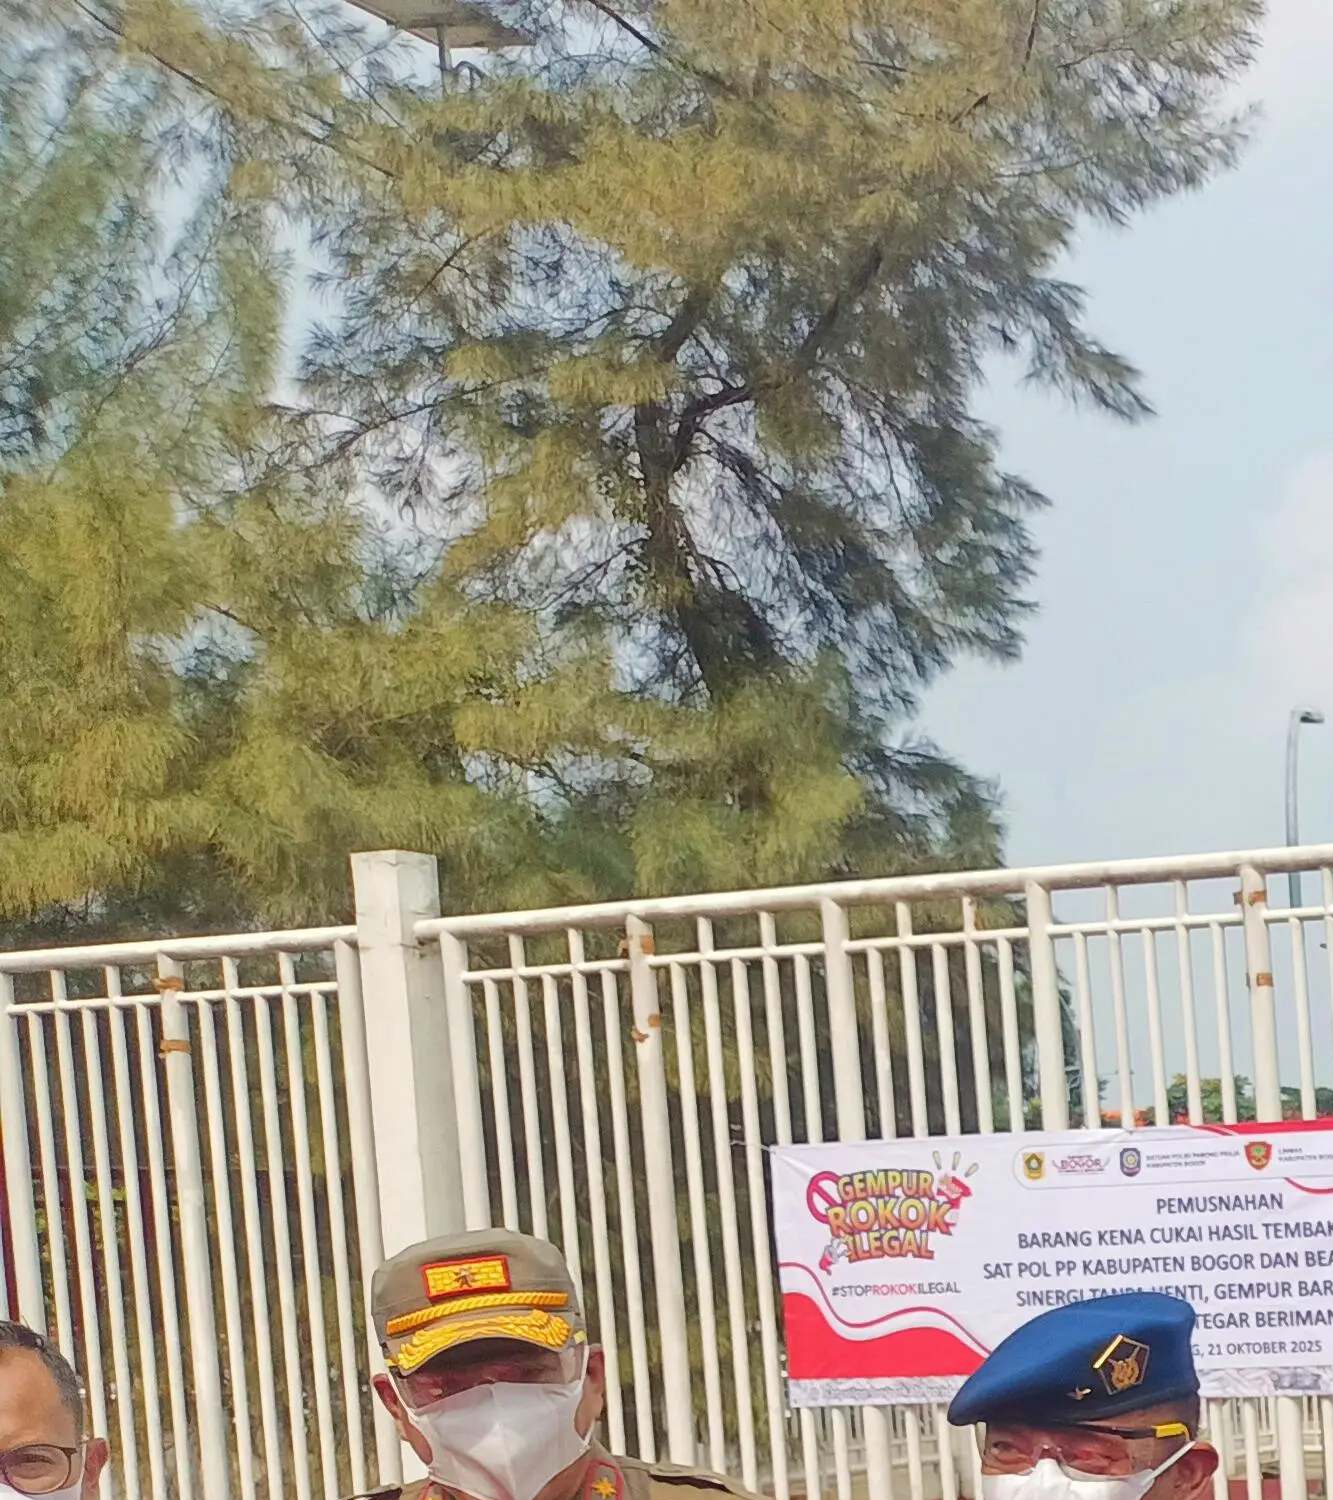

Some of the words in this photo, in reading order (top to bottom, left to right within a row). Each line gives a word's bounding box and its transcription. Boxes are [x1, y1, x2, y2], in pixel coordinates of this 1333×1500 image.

[837, 1169, 935, 1200] GEMPUR
[1156, 1192, 1284, 1215] PEMUSNAHAN
[826, 1197, 954, 1238] ROKOK
[843, 1230, 935, 1263] ILEGAL
[1017, 1230, 1092, 1249] BARANG
[1098, 1228, 1146, 1246] KENA
[1149, 1226, 1203, 1244] CUKAI
[1208, 1224, 1259, 1242] HASIL
[983, 1262, 1013, 1280] SAT
[1018, 1261, 1051, 1278] POL
[1055, 1260, 1077, 1276] PP
[1082, 1256, 1185, 1276] KABUPATEN
[1190, 1252, 1255, 1272] BOGOR
[1260, 1252, 1299, 1270] DAN
[832, 1282, 961, 1297] #STOPROKOKILEGAL
[1016, 1288, 1084, 1307] SINERGI
[1214, 1280, 1292, 1300] GEMPUR
[1195, 1312, 1251, 1330] TEGAR
[1208, 1343, 1224, 1356] 21
[1226, 1340, 1287, 1356] OKTOBER
[1291, 1340, 1322, 1354] 2025
